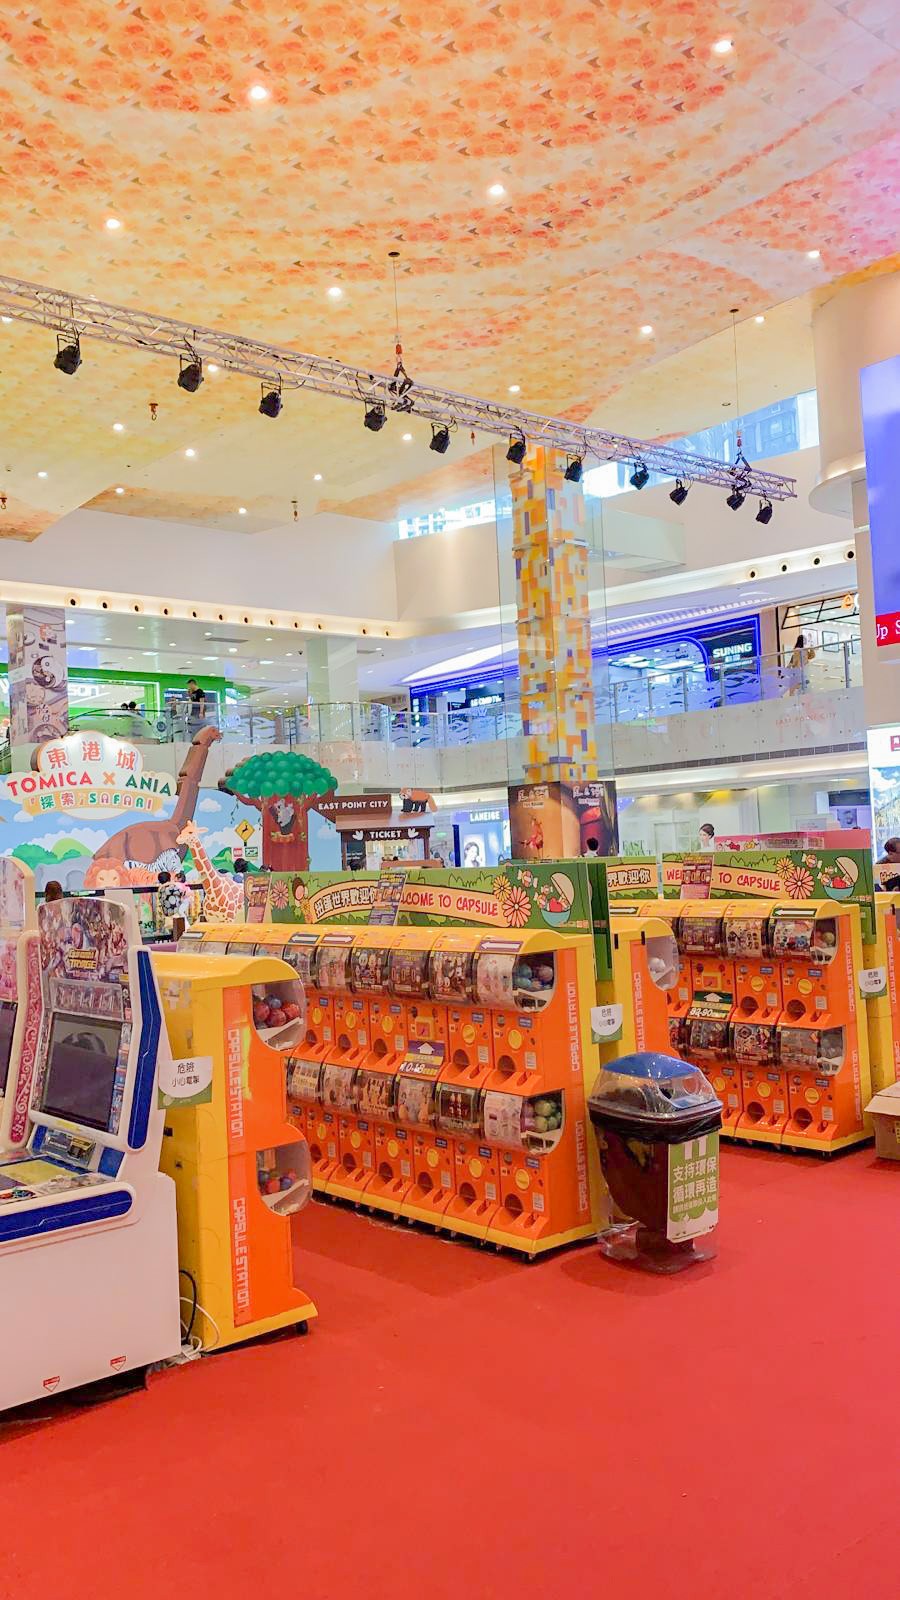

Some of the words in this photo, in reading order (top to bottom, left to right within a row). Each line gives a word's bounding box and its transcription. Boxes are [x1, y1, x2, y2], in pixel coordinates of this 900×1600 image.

[712, 643, 753, 658] SUNING
[46, 741, 136, 771] 東港城
[7, 771, 93, 796] TOMICA
[125, 774, 171, 796] ANIA
[89, 793, 152, 810] SAFARI
[318, 803, 338, 811] EAST
[470, 811, 501, 822] LANEIGE
[369, 830, 401, 839] TICKET
[719, 872, 732, 884] TO
[736, 874, 780, 891] CAPSULE
[438, 894, 452, 908] TO
[456, 897, 499, 917] CAPSULE
[567, 981, 577, 1024] STATION
[228, 1029, 241, 1086] CAPSULE
[569, 1024, 579, 1072] CAPSULE
[229, 1086, 244, 1139] STATION
[673, 1156, 718, 1183] 支持環保
[673, 1176, 718, 1205] 循環再造
[233, 1197, 247, 1255] CAPSULE
[235, 1255, 250, 1309] STATION
